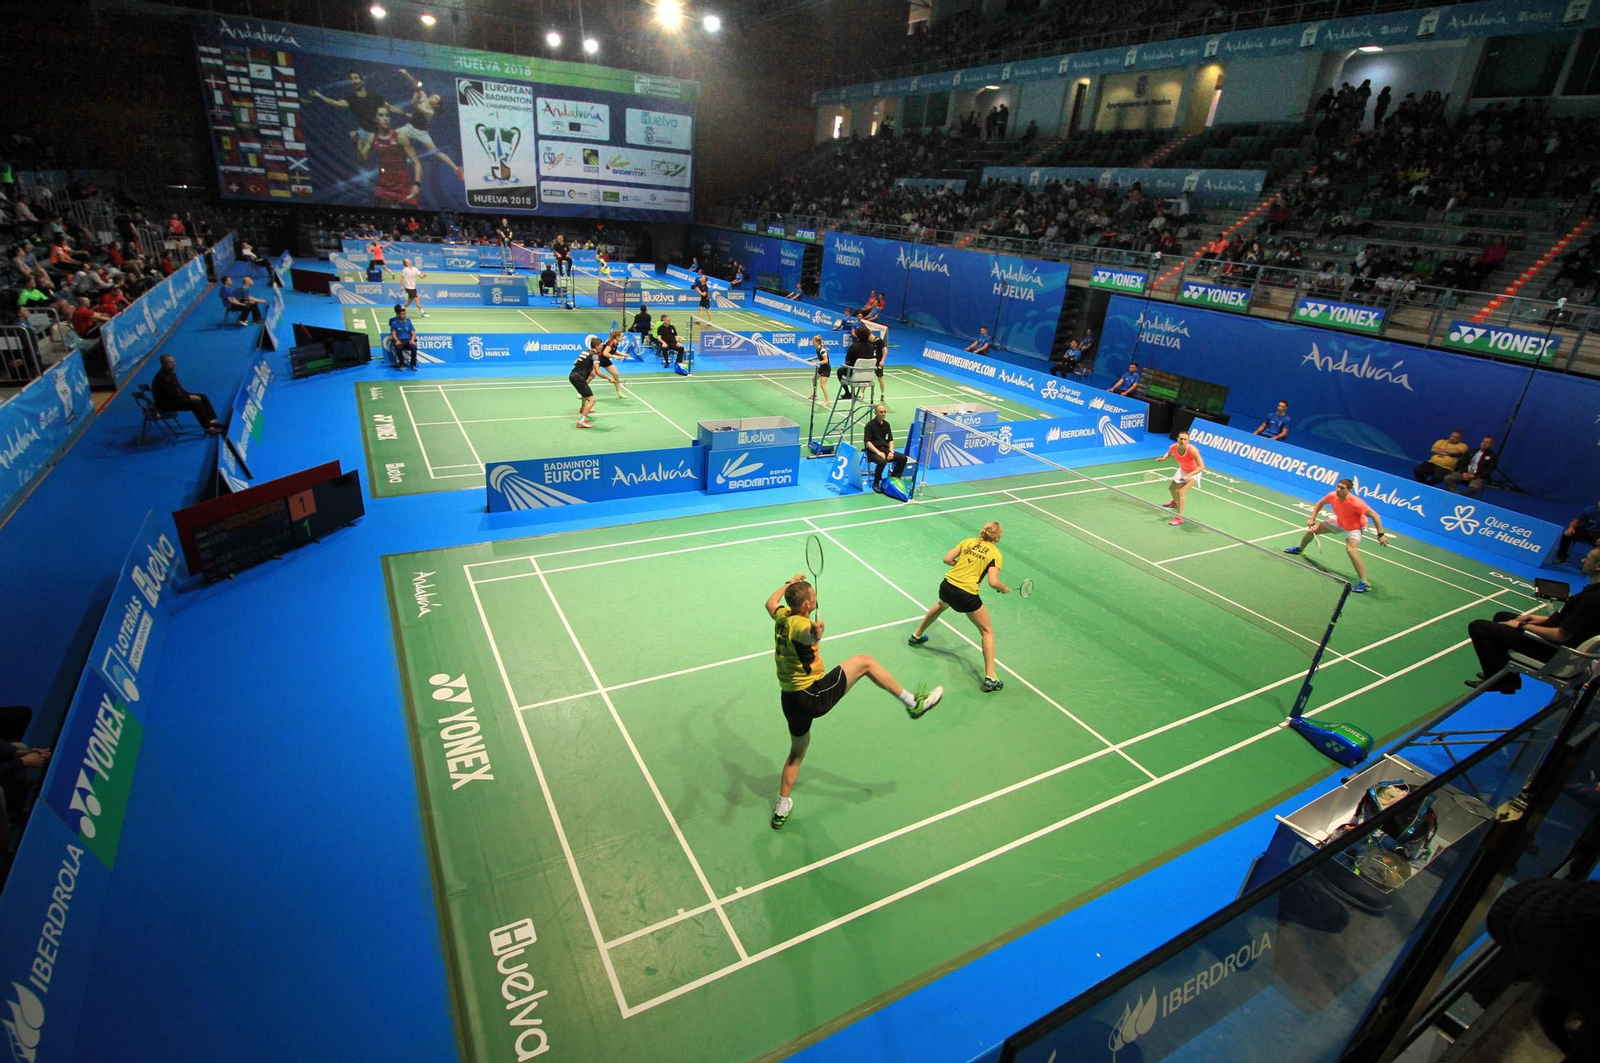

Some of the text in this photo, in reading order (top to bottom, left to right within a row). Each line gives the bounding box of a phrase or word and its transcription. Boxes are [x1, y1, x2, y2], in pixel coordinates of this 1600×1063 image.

[219, 19, 301, 48] Andalucía
[454, 57, 532, 76] HUELVA 2018
[485, 82, 532, 95] EUROPEAN
[485, 93, 532, 104] BADMINTON
[486, 102, 532, 113] CHAMPIONSHIPS
[543, 100, 604, 123] Andalucía
[641, 112, 678, 128] Huelva
[1204, 179, 1247, 192] Andalucía
[474, 194, 532, 206] HUELVA 2018
[834, 238, 865, 256] Andalucía
[835, 254, 861, 268] HUELVA
[896, 246, 950, 277] Andalucía
[990, 261, 1045, 288] Andalucía
[1111, 273, 1144, 290] YONEX
[642, 291, 675, 303] Huelva
[992, 282, 1035, 302] HUELVA
[1206, 288, 1247, 307] YONEX
[1135, 312, 1191, 338] Andalucía
[1328, 305, 1379, 328] YONEX
[416, 341, 453, 350] EUROPE
[1138, 331, 1181, 350] HUELVA
[1488, 331, 1554, 358] YONEX
[923, 347, 1035, 392] BADMINTONEUROPE.COM Andalucía
[1301, 342, 1415, 392] Andalucía
[1060, 385, 1081, 397] Que sea
[1064, 394, 1085, 406] Huelva
[954, 415, 982, 426] Huelva
[1120, 412, 1145, 421] BADMINTON
[1120, 418, 1145, 429] EUROPE
[375, 422, 399, 441] YONEX
[737, 430, 775, 445] Huelva
[1060, 428, 1096, 439] IBERDROLA
[964, 436, 997, 449] EUROPE
[543, 459, 600, 472] BADMINTON
[1189, 428, 1340, 486] BADMINTONEUROPE.COM
[544, 468, 600, 485] EUROPE
[611, 460, 698, 487] Andalucía
[769, 468, 793, 476] ESPAÑA
[831, 455, 848, 481] 3
[728, 475, 792, 490] BADMINTON
[298, 496, 307, 513] 1
[303, 519, 311, 537] 1
[1484, 515, 1533, 539] Que sea
[1478, 526, 1542, 554] de Huelva
[131, 533, 176, 608] Huelva
[413, 570, 442, 619] Andalucía
[115, 595, 143, 657] LOTERÍAS
[83, 693, 127, 781] YONEX
[1339, 723, 1368, 743] YONEX
[438, 706, 495, 791] YONEX
[29, 843, 85, 994] IBERDROLA
[1162, 931, 1273, 1018] IBERDROLA
[489, 917, 550, 1063] Huelva
